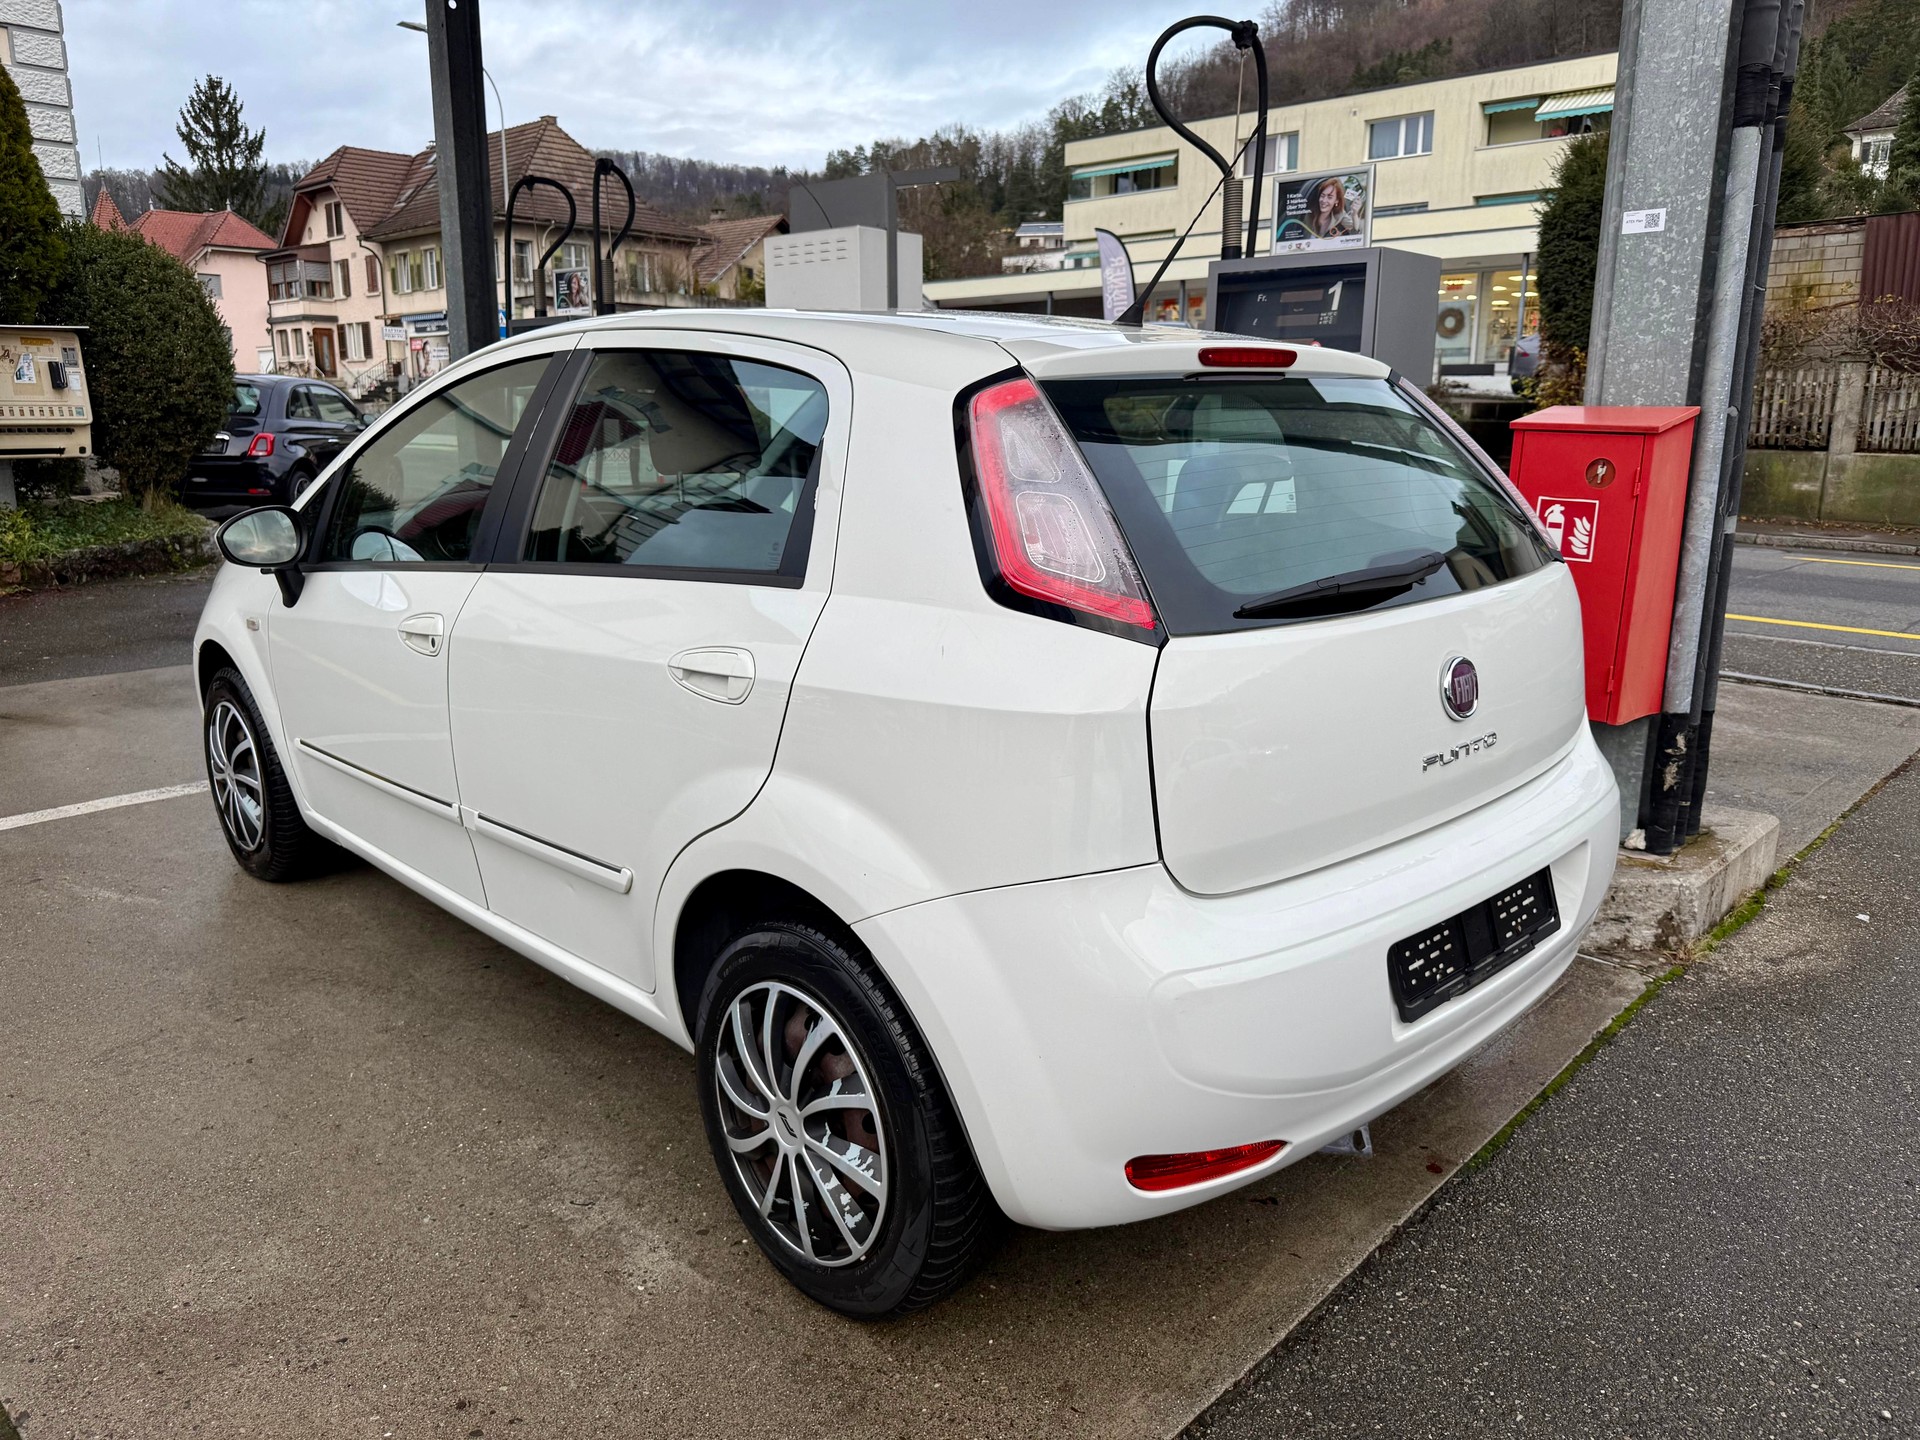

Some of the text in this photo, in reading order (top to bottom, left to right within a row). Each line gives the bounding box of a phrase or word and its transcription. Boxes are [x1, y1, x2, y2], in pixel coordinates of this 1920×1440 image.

[1257, 294, 1268, 302] Fr.
[1327, 280, 1344, 311] 1
[1453, 672, 1477, 705] FIAT
[1422, 730, 1498, 773] PUNTO
